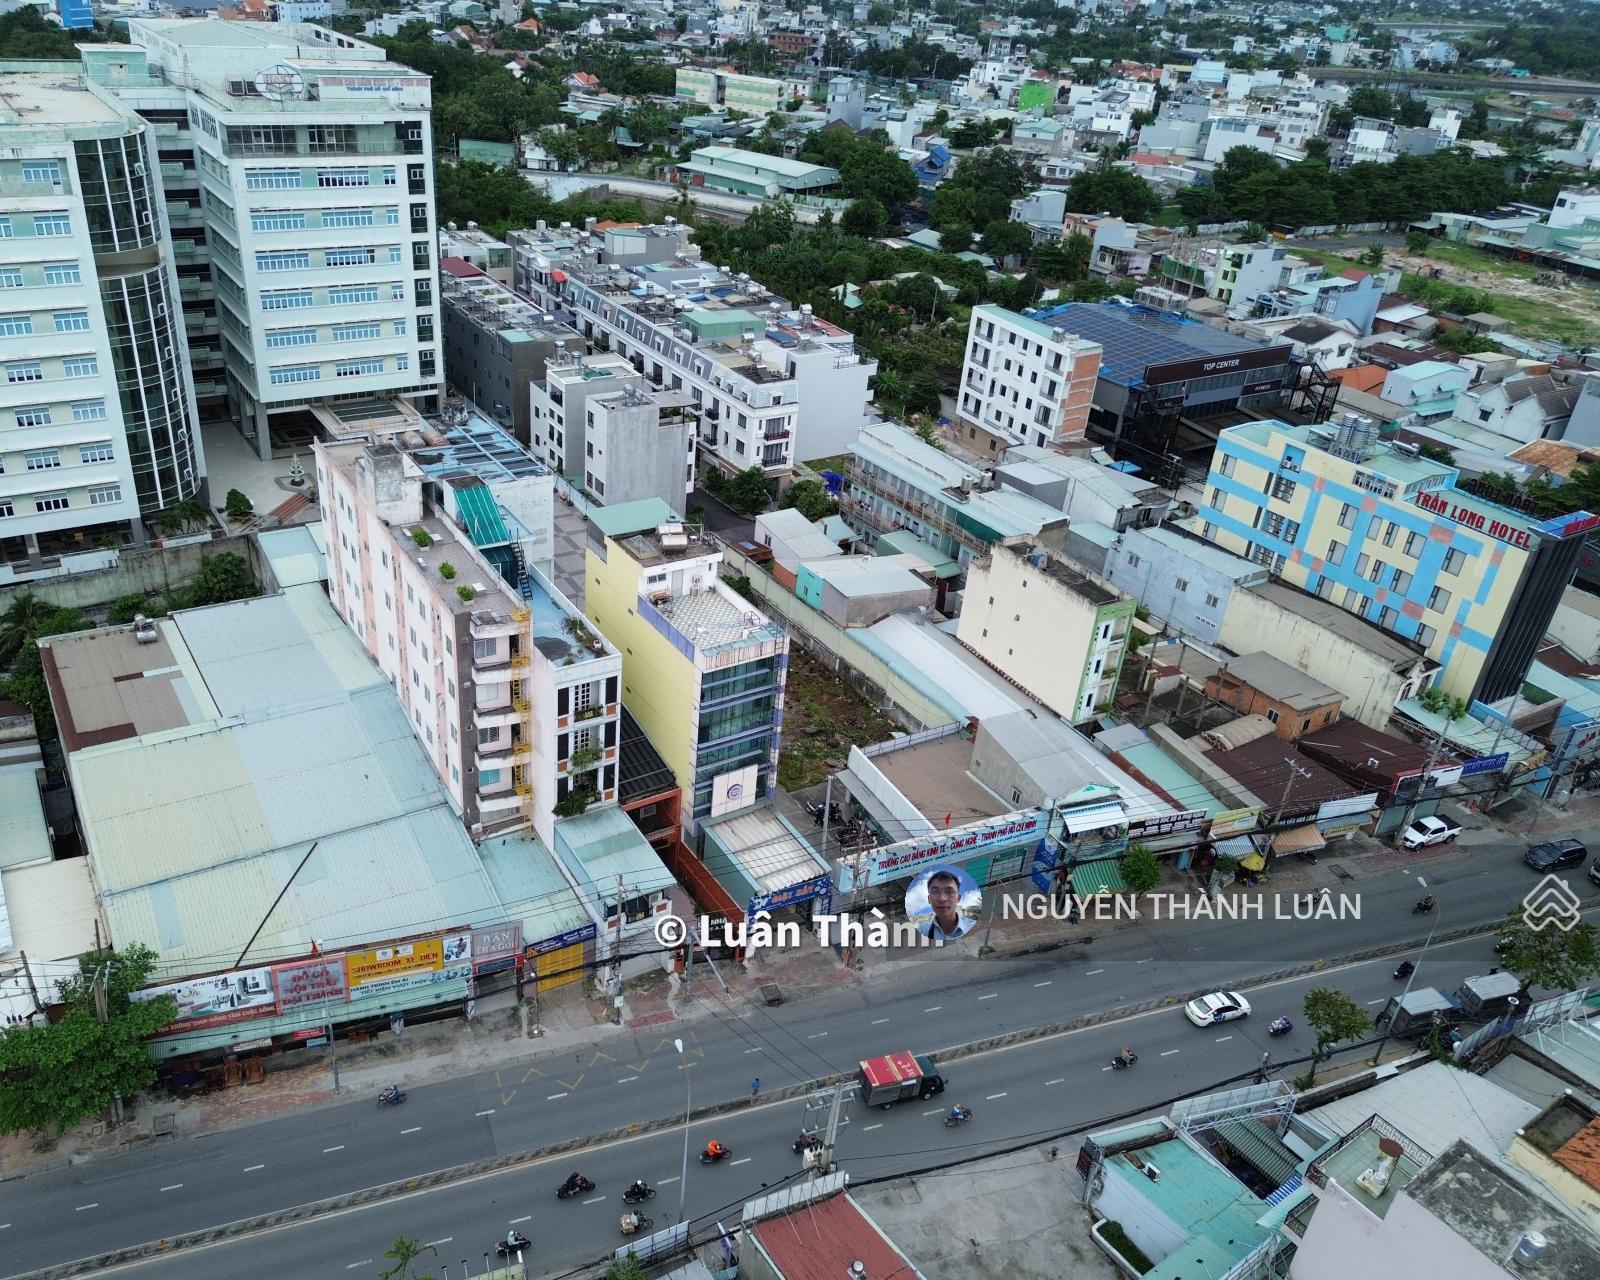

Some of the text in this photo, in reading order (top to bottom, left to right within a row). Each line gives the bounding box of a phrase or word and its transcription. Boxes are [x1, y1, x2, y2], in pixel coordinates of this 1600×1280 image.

[1203, 359, 1240, 371] TOP CENTER
[1450, 505, 1486, 530] LONG
[1488, 519, 1532, 549] HOTEL
[352, 959, 401, 974] SHOWROOM
